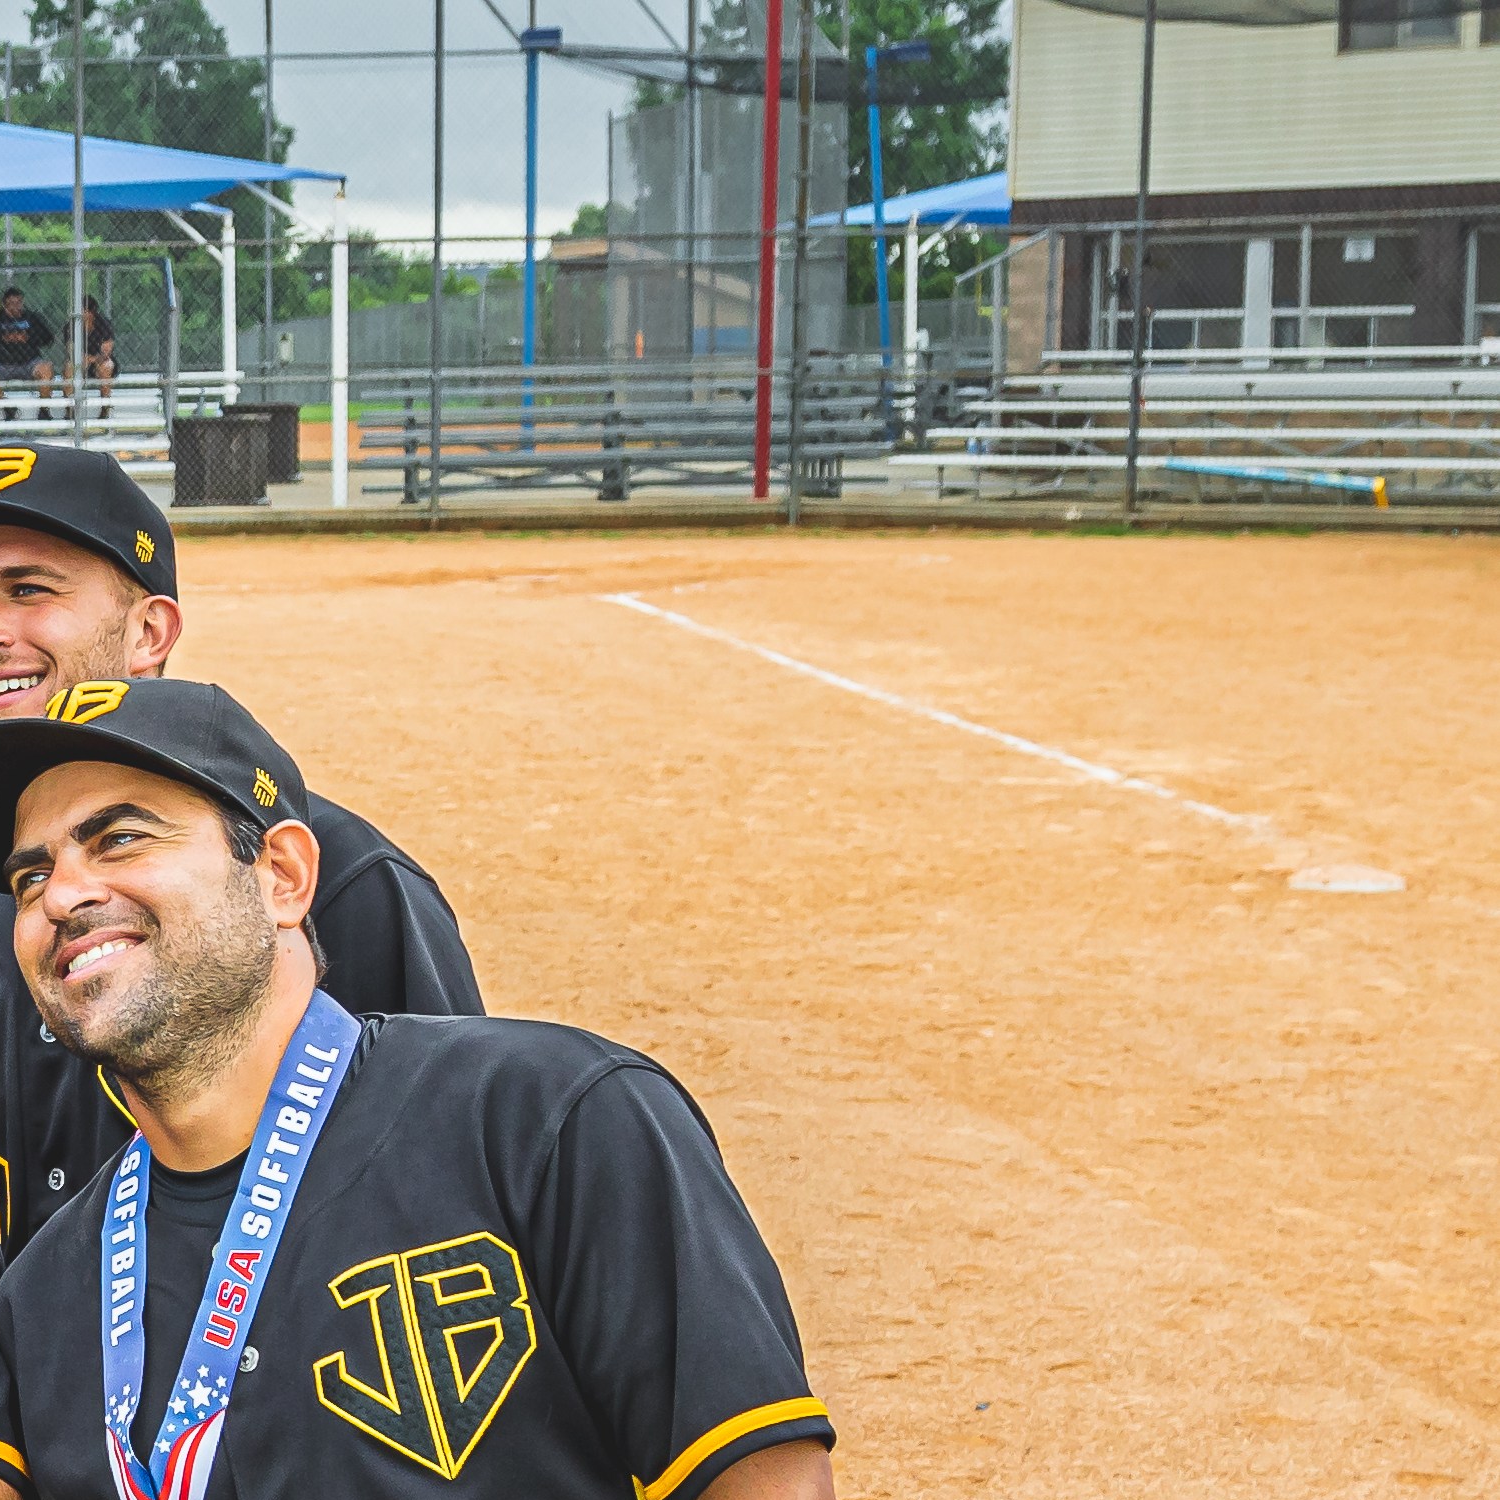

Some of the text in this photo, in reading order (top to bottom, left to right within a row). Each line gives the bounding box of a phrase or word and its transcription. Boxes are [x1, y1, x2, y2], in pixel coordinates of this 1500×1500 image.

[110, 1150, 142, 1349] SOFTBALL
[201, 1042, 340, 1350] USA SOFTBALL
[313, 1230, 538, 1481] JB
